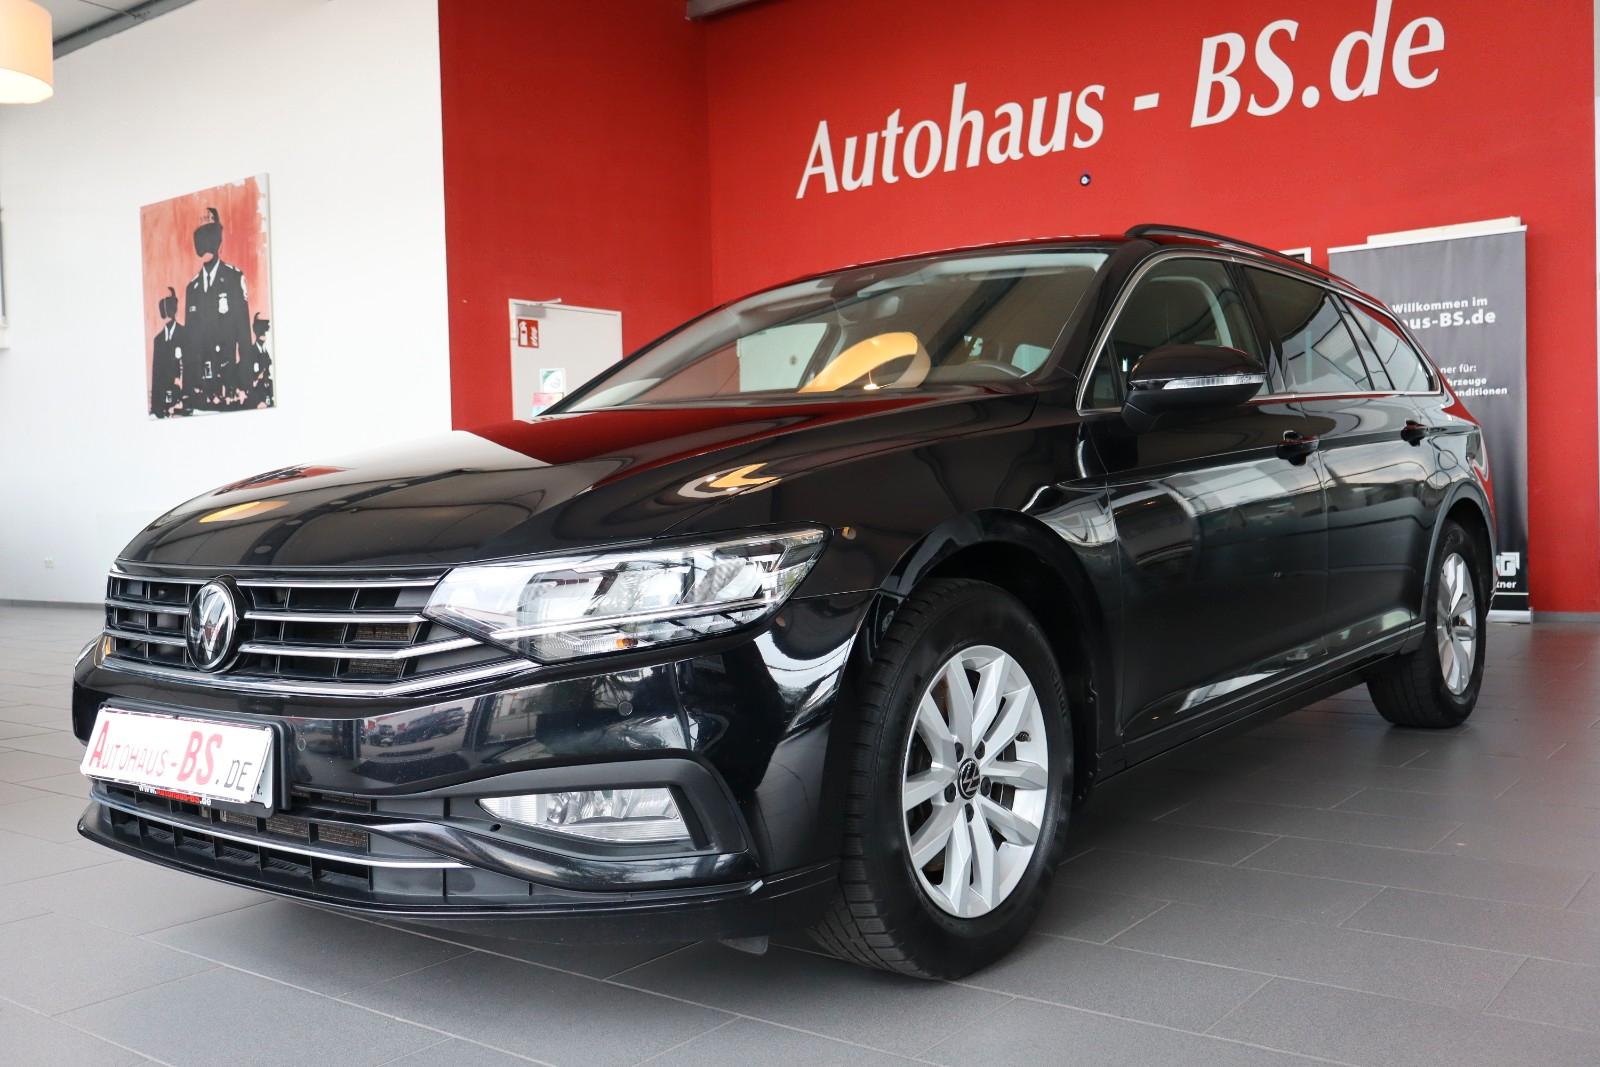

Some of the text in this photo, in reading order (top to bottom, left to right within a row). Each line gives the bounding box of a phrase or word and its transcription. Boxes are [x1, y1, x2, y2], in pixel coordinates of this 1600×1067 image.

[796, 0, 1445, 199] Autohaus - BS.de
[1392, 296, 1488, 314] Willkommen im
[1459, 363, 1477, 374] für:
